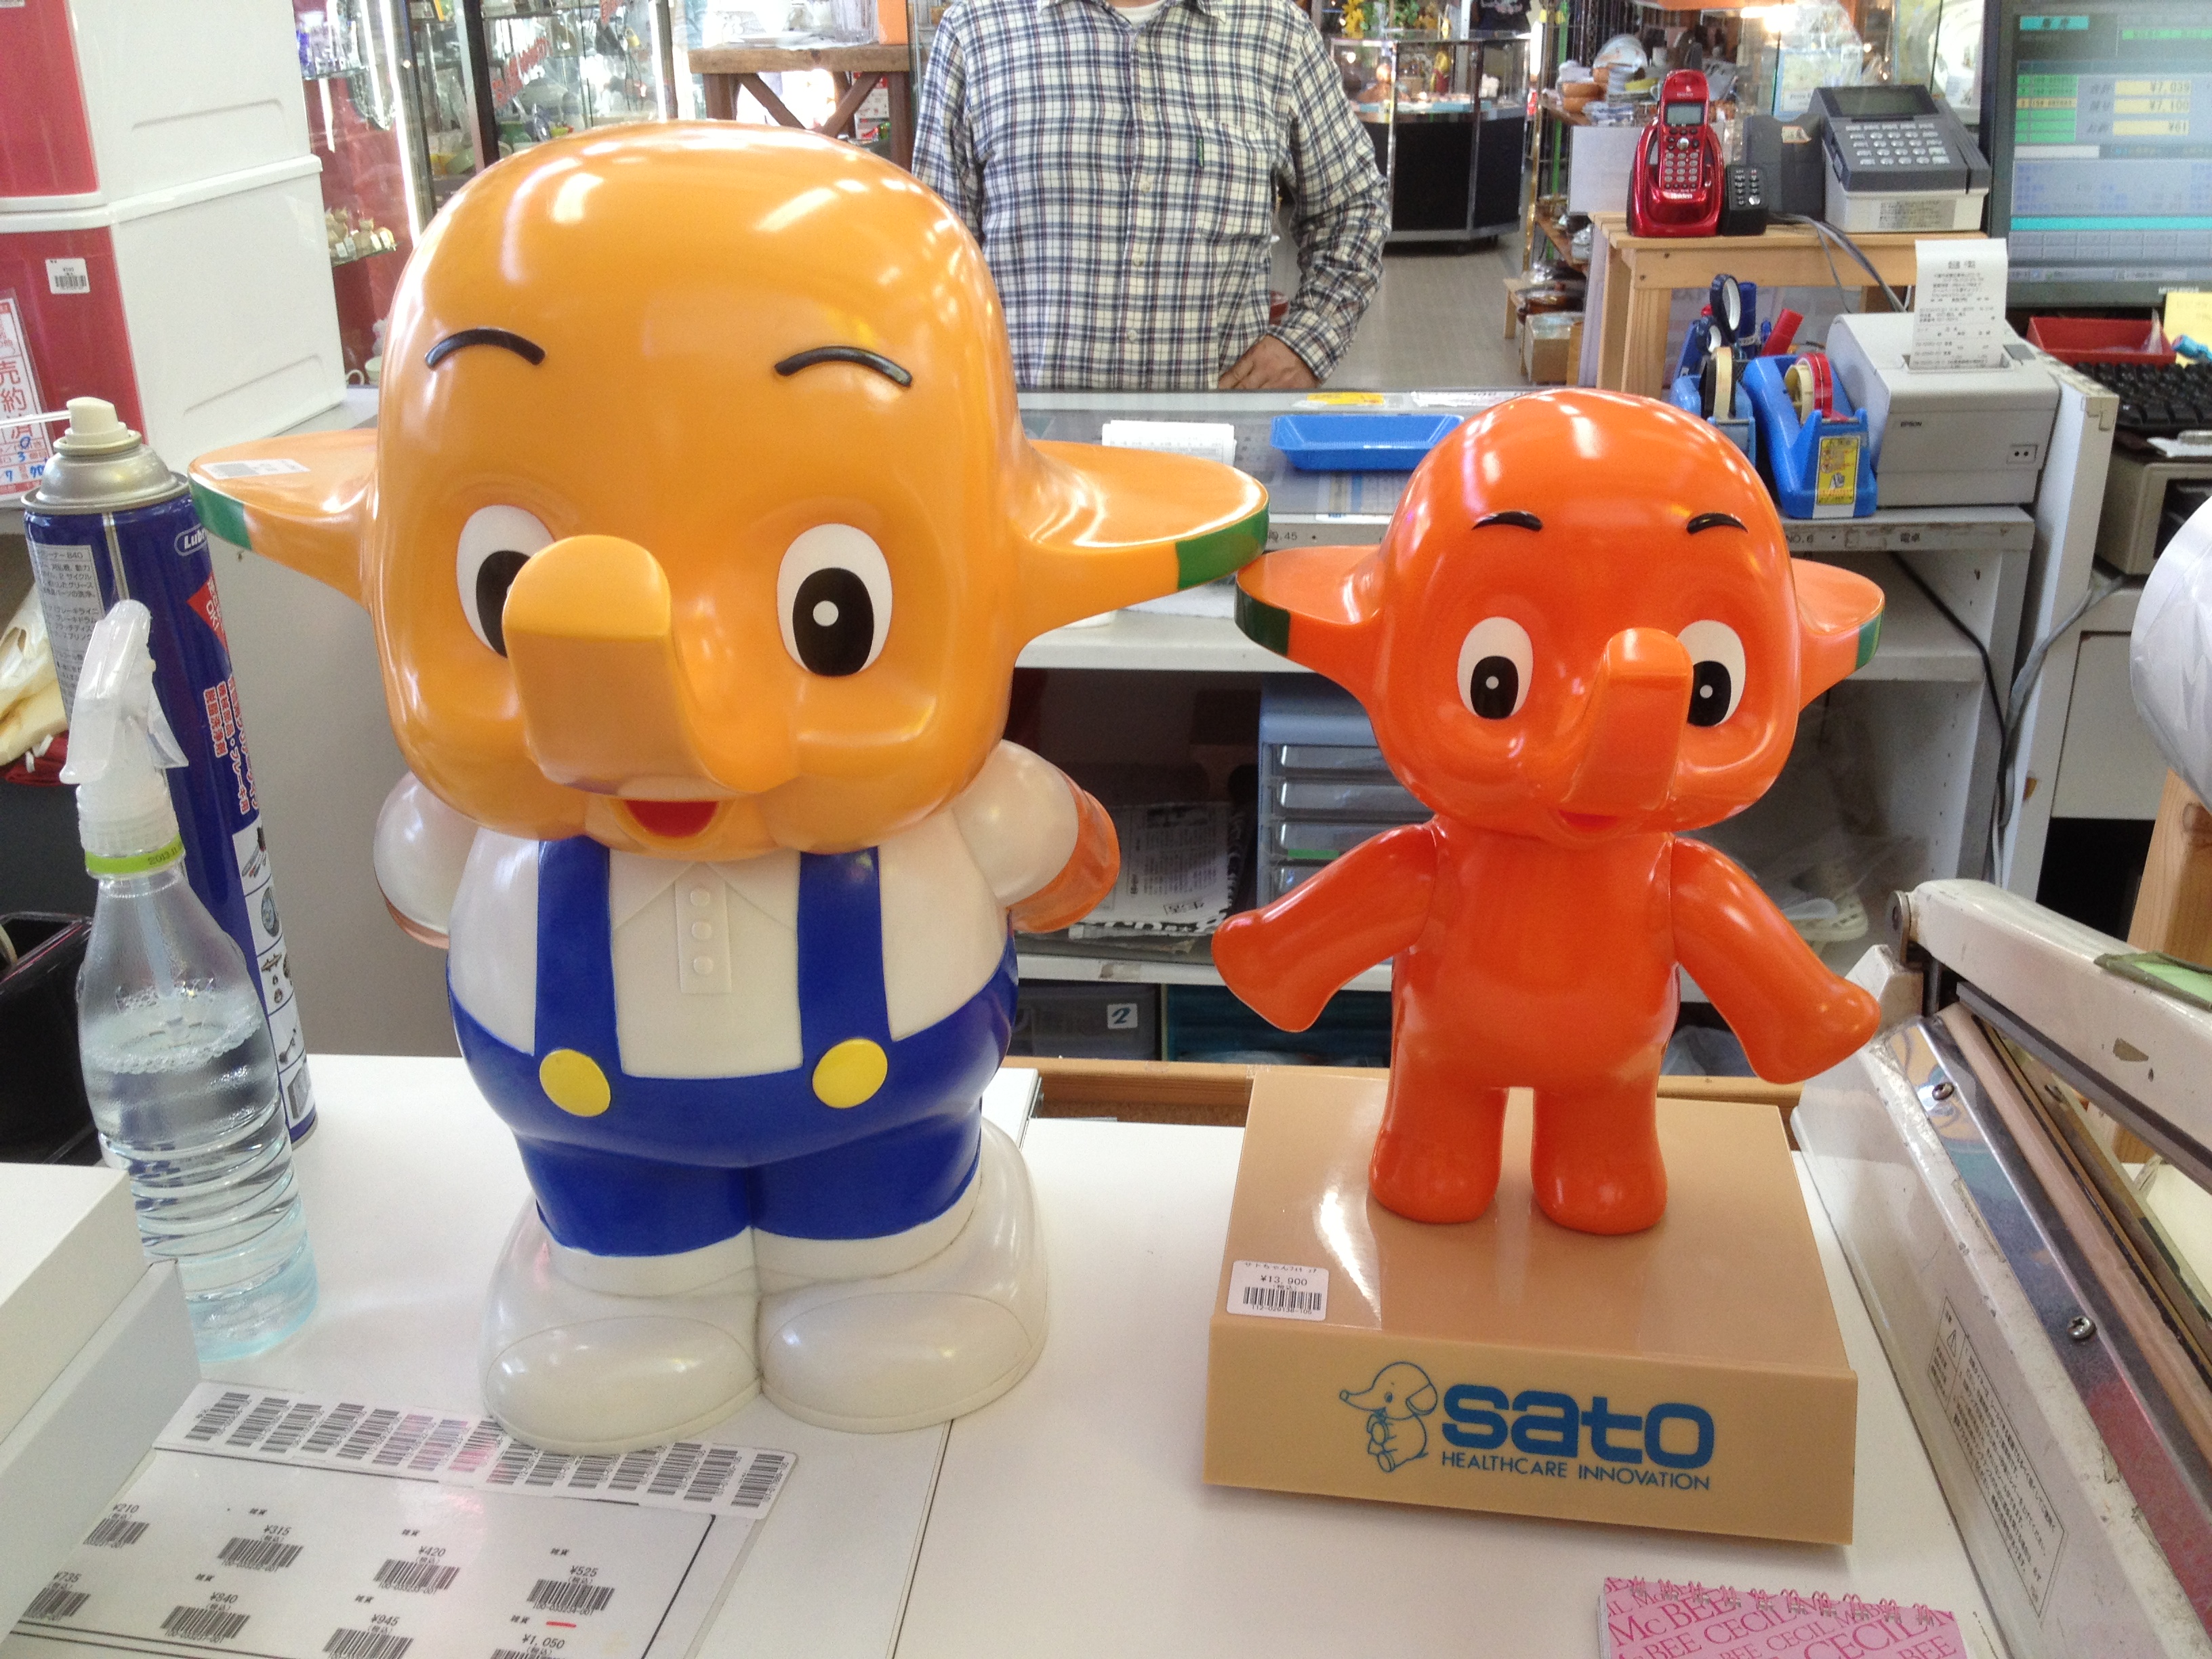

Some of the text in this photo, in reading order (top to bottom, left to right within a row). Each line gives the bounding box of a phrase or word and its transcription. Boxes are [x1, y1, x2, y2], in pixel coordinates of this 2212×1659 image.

[1111, 1007, 1132, 1025] 2
[1261, 1275, 1308, 1286] ¥13,900
[1441, 1383, 1715, 1470] sato
[1441, 1450, 1711, 1491] HEALTHCARE INNOVATION
[522, 1633, 565, 1650] ¥1,050
[1766, 1620, 1835, 1651] CECIL
